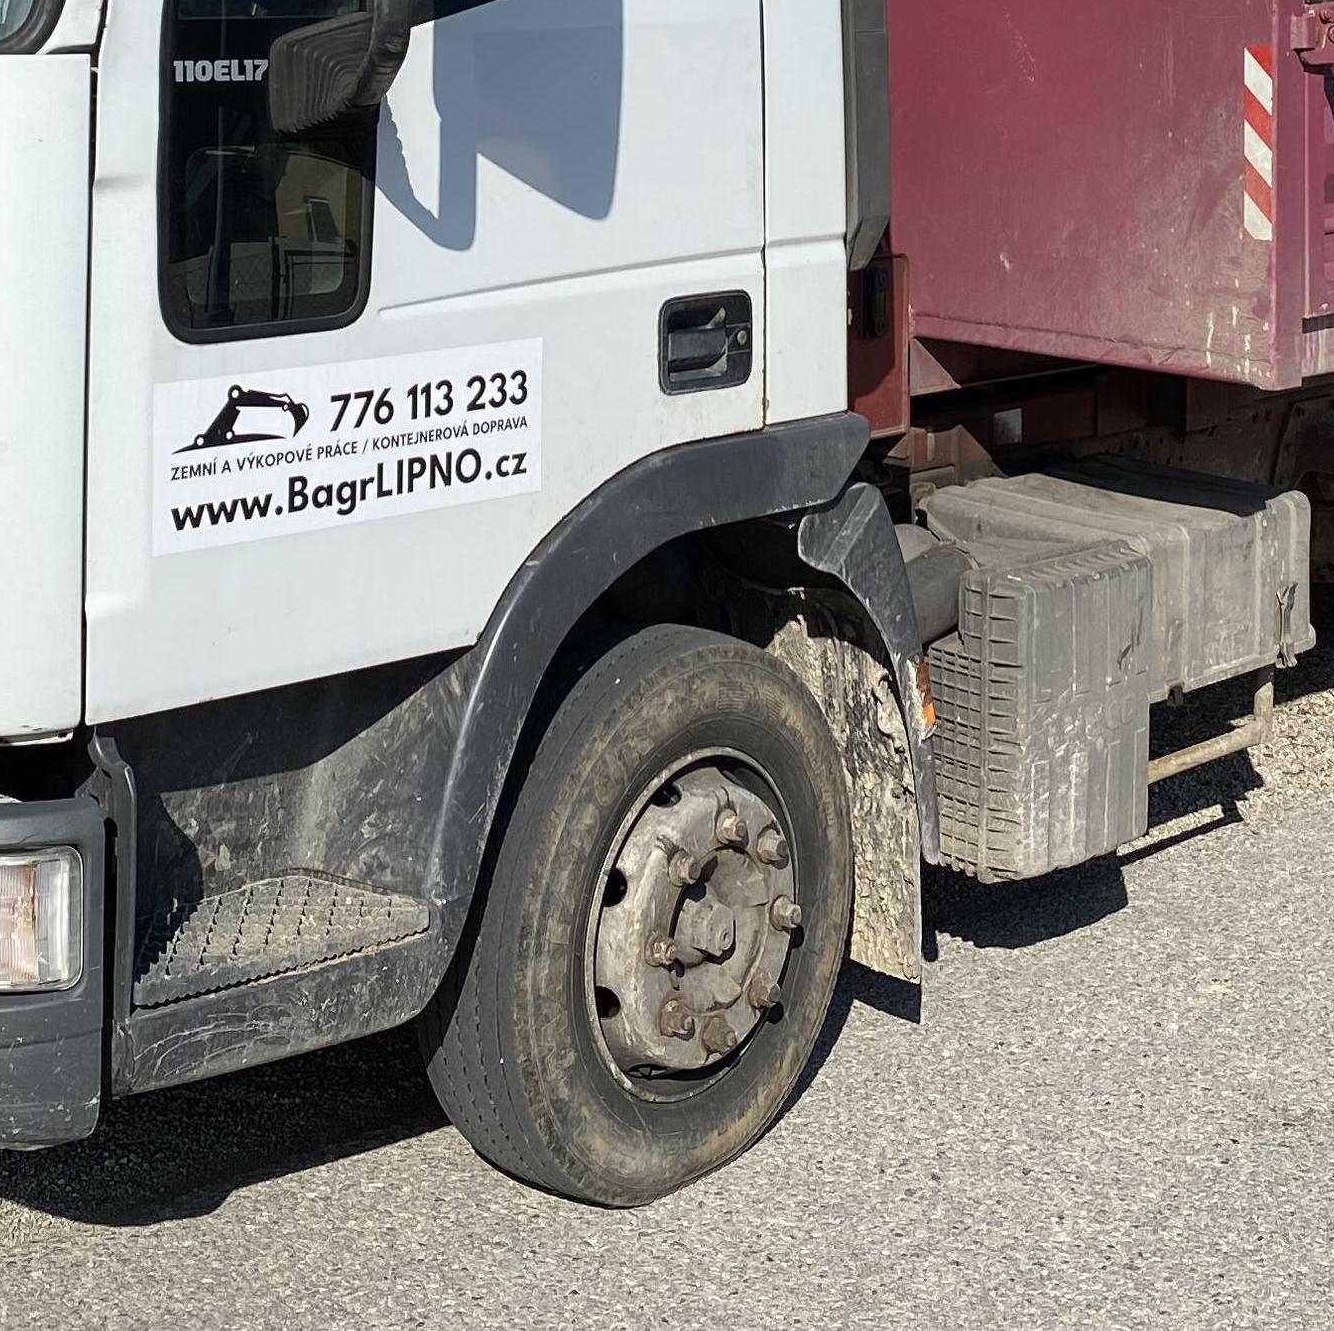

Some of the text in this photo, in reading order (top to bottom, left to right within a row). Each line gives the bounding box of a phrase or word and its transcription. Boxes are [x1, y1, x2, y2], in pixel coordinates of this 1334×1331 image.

[173, 59, 269, 82] 110EL17
[330, 370, 528, 432] 776 113 233
[171, 457, 216, 481] ZEMNÍ
[221, 460, 231, 474] A
[236, 443, 312, 471] VÝKOPOVÉ
[317, 438, 358, 460] PRÁCE
[372, 420, 469, 451] KONTEJNEROVÁ
[472, 415, 528, 436] DOPRAVA
[171, 448, 527, 531] www.BagrLIPNO.cz
